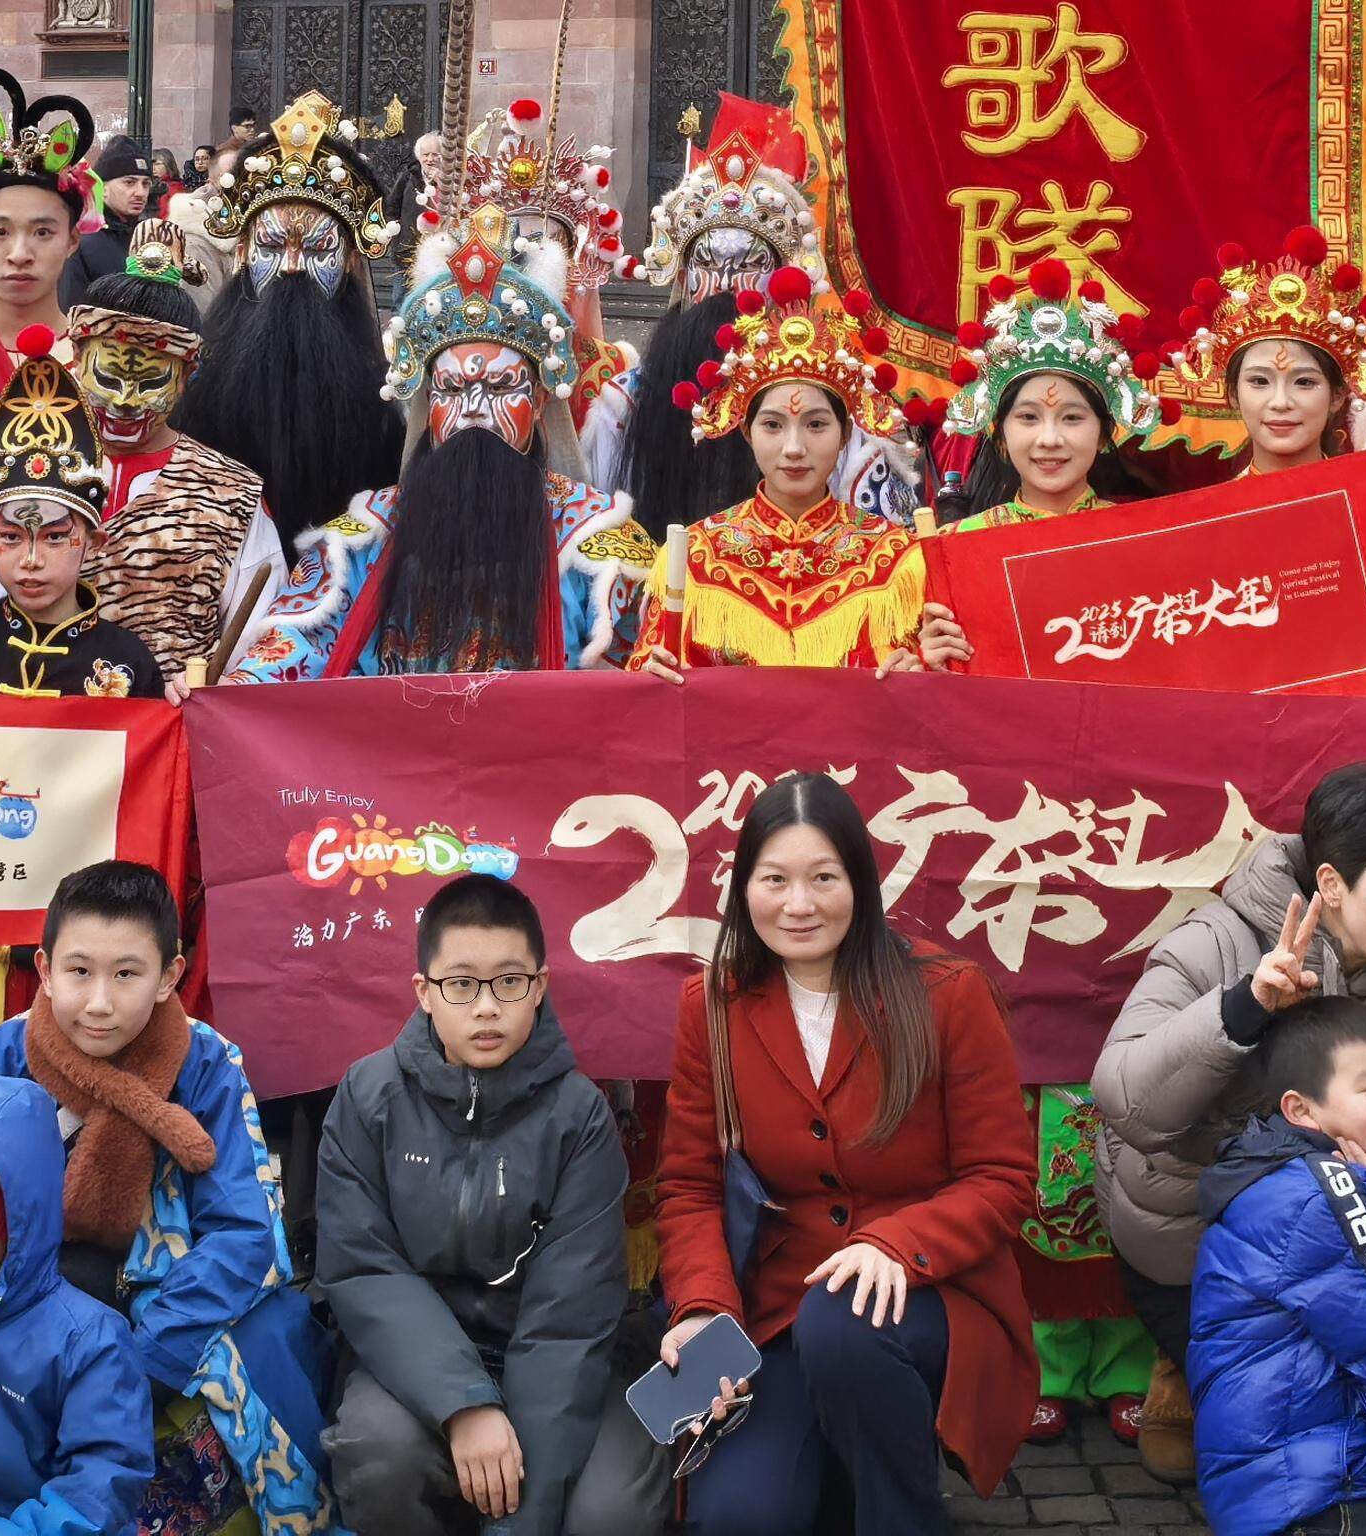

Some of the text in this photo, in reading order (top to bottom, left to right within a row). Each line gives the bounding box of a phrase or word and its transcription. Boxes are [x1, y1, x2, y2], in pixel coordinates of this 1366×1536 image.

[481, 61, 492, 73] 21
[1080, 600, 1123, 625] 2025
[278, 786, 375, 811] Truly Enjoy
[307, 827, 516, 881] GuangDong
